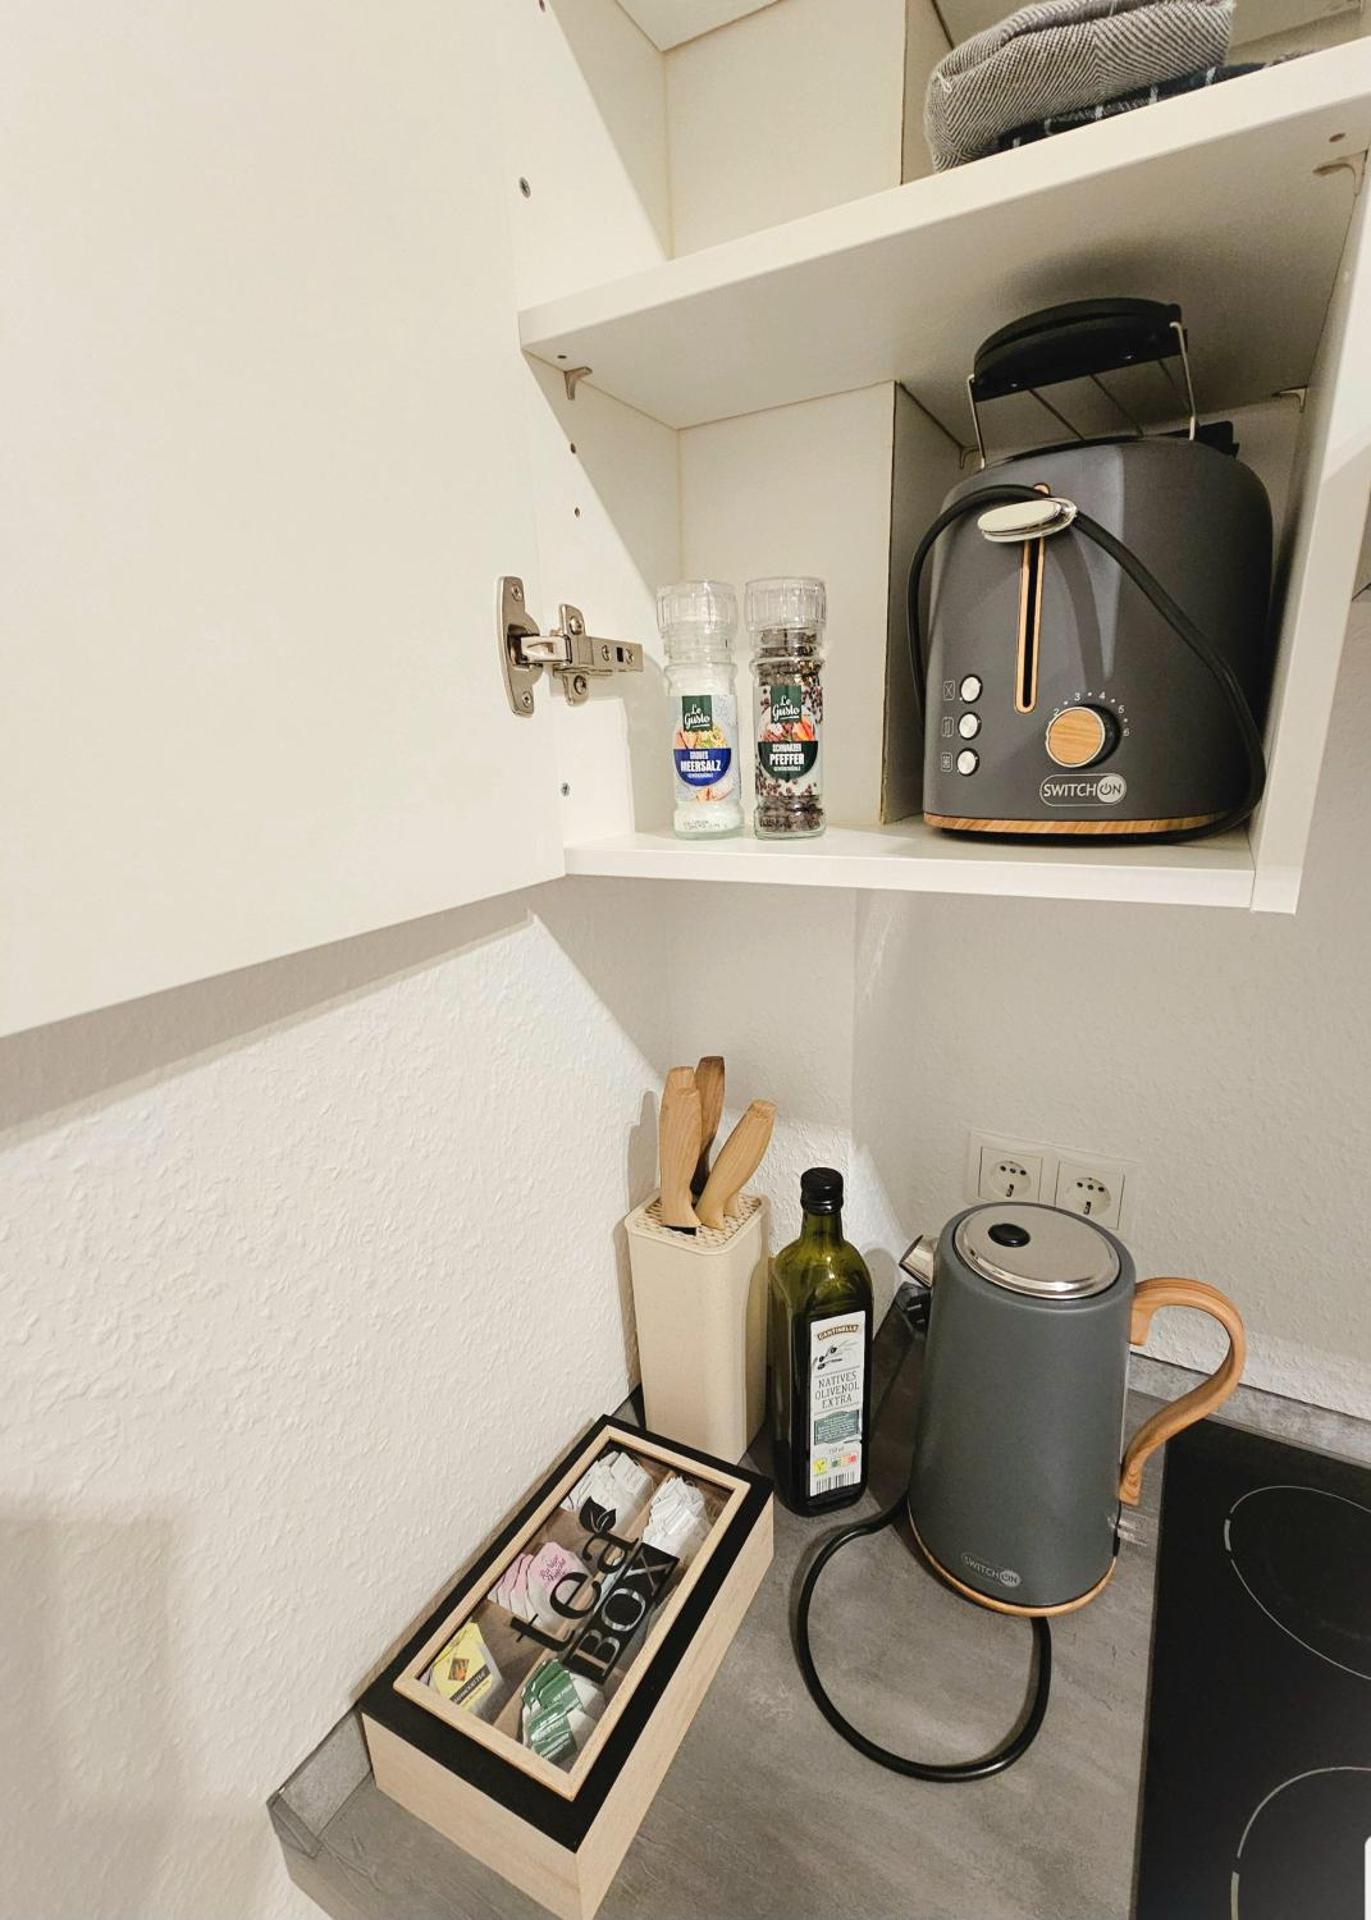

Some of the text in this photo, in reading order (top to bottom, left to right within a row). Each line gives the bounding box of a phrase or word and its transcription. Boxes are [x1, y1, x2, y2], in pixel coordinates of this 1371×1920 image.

[1074, 692, 1081, 701] 3
[1099, 691, 1105, 700] 4
[684, 713, 711, 728] Gusto
[773, 705, 800, 721] Gusto
[680, 759, 722, 772] MEERSALZ
[769, 753, 805, 766] PFEFFER
[818, 1370, 857, 1389] NATIVES
[822, 1394, 852, 1409] EXTRA
[510, 1532, 640, 1652] tea
[569, 1550, 676, 1677] BOX
